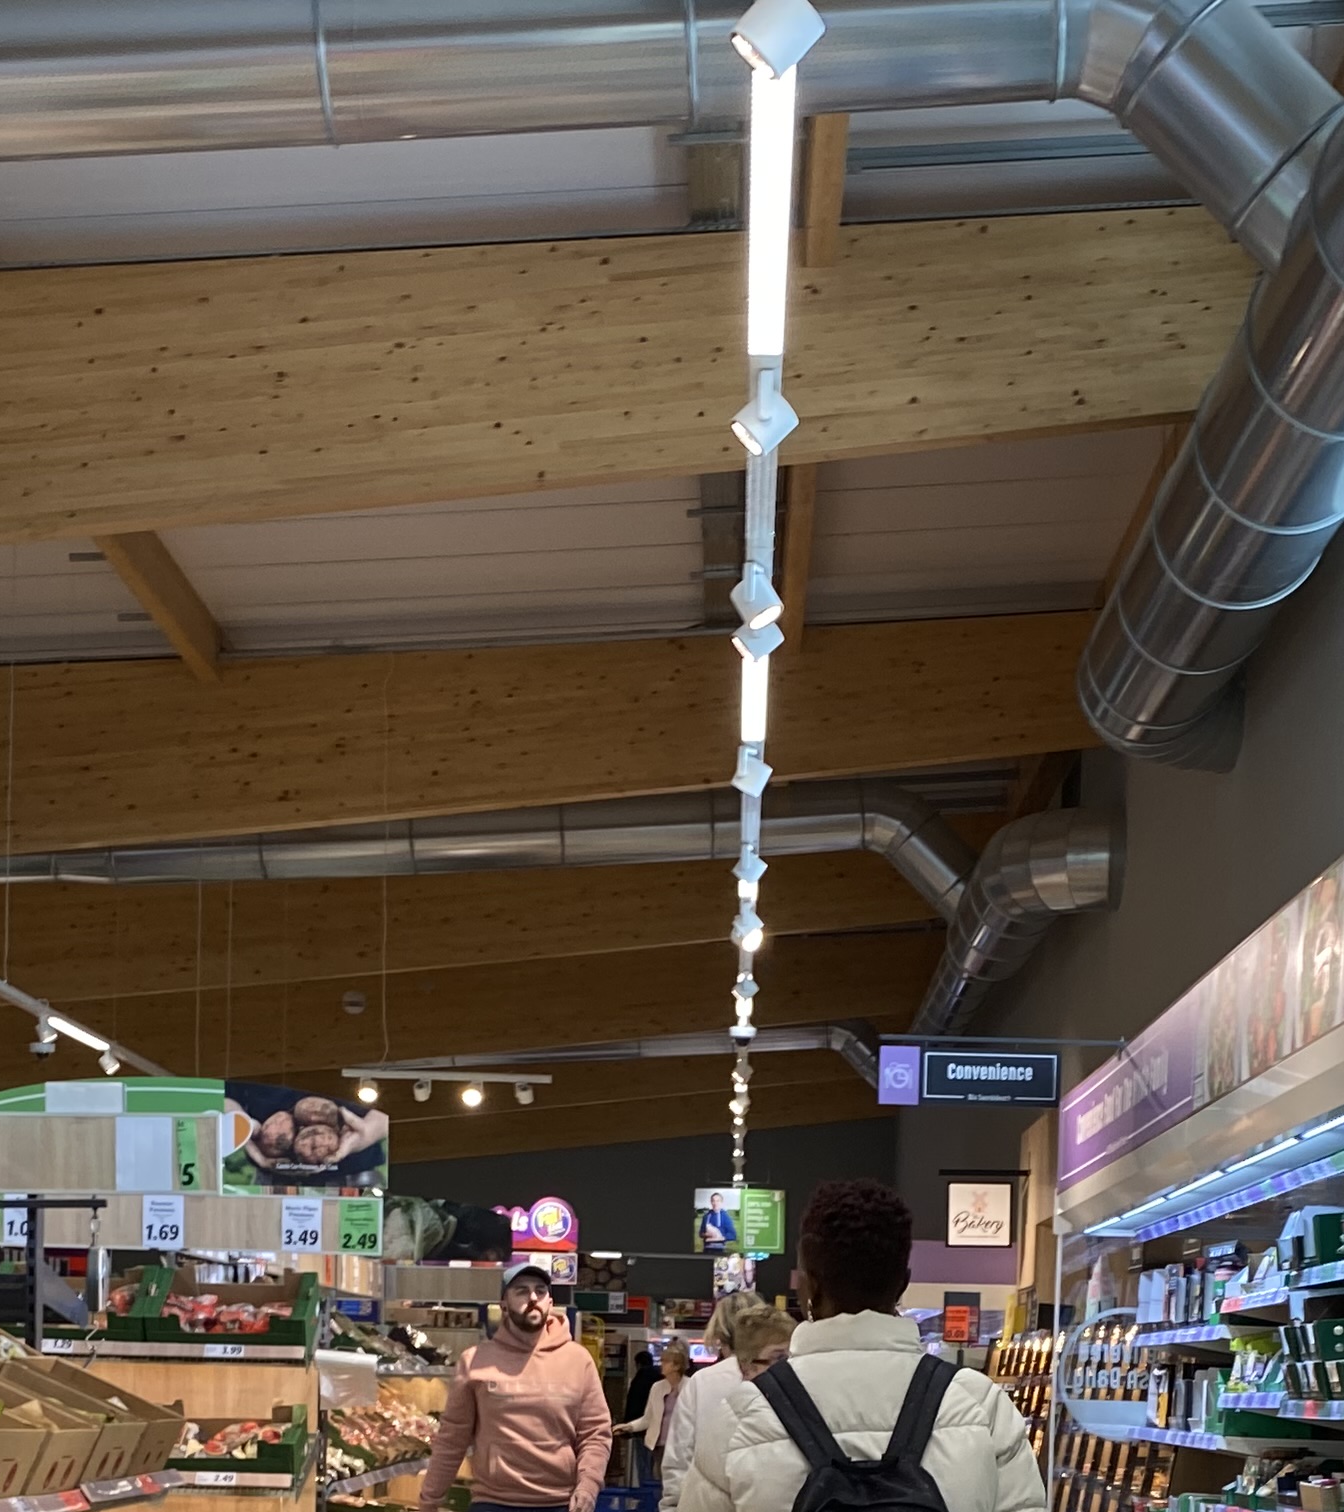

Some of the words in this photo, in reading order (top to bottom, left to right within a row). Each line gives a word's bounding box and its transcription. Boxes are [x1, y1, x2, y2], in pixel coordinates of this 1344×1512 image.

[946, 1062, 1034, 1081] Convenience
[6, 1220, 28, 1237] 1.0
[952, 1210, 1004, 1235] Bakery
[145, 1223, 179, 1241] 1.69
[284, 1229, 319, 1246] 3.49
[342, 1232, 377, 1249] 2.49
